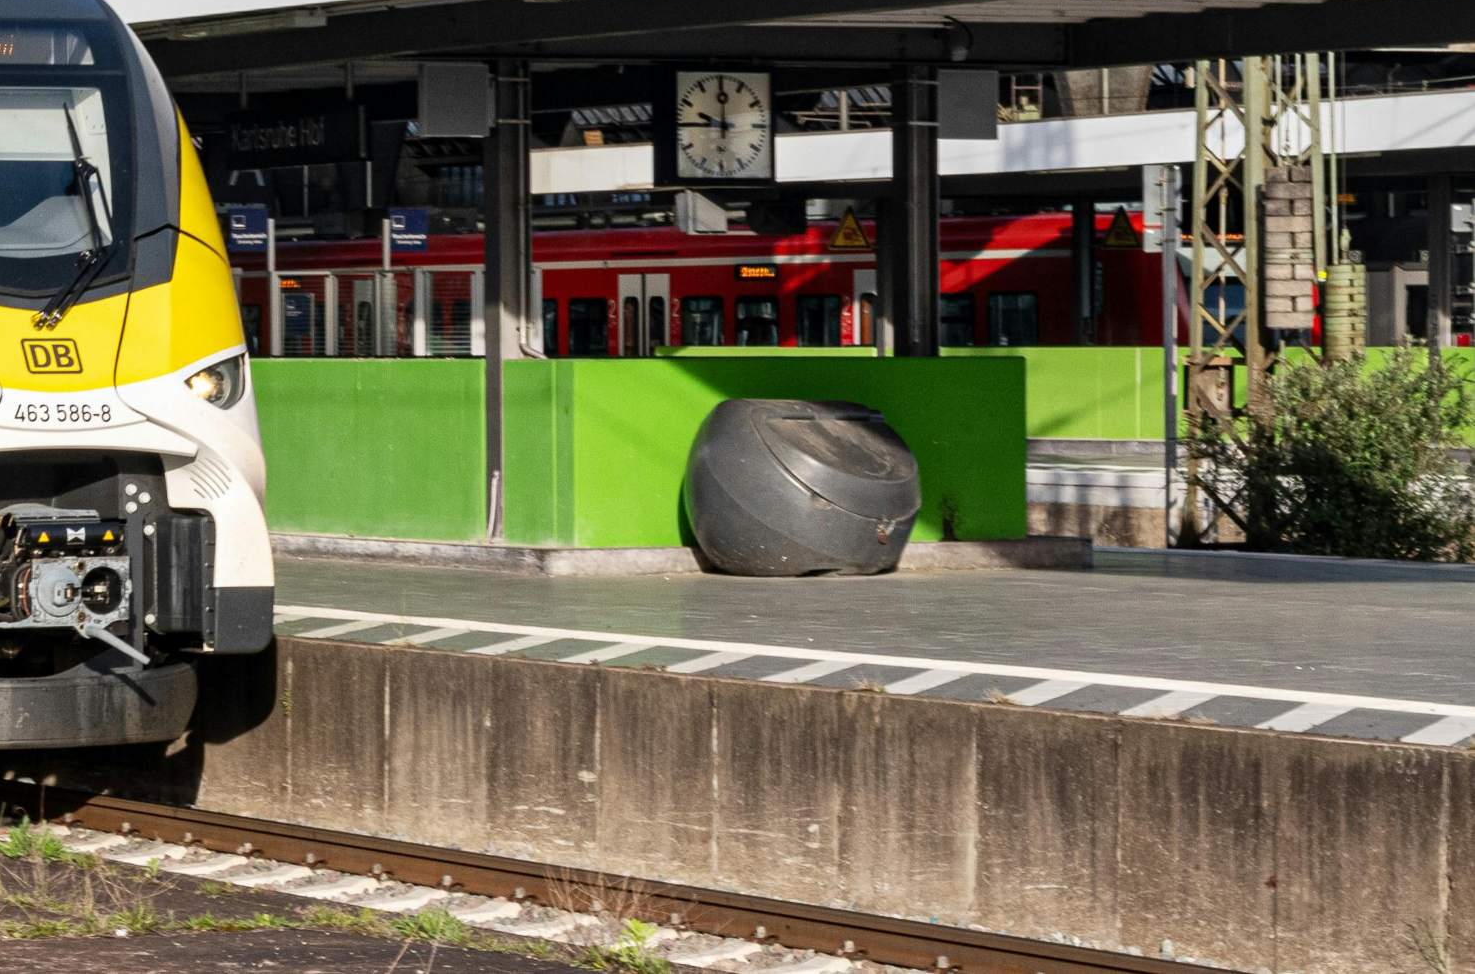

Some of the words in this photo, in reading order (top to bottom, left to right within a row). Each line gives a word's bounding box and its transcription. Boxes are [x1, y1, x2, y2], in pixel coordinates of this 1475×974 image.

[29, 344, 74, 368] DB
[14, 403, 51, 423] 463
[56, 403, 112, 423] 586-8
